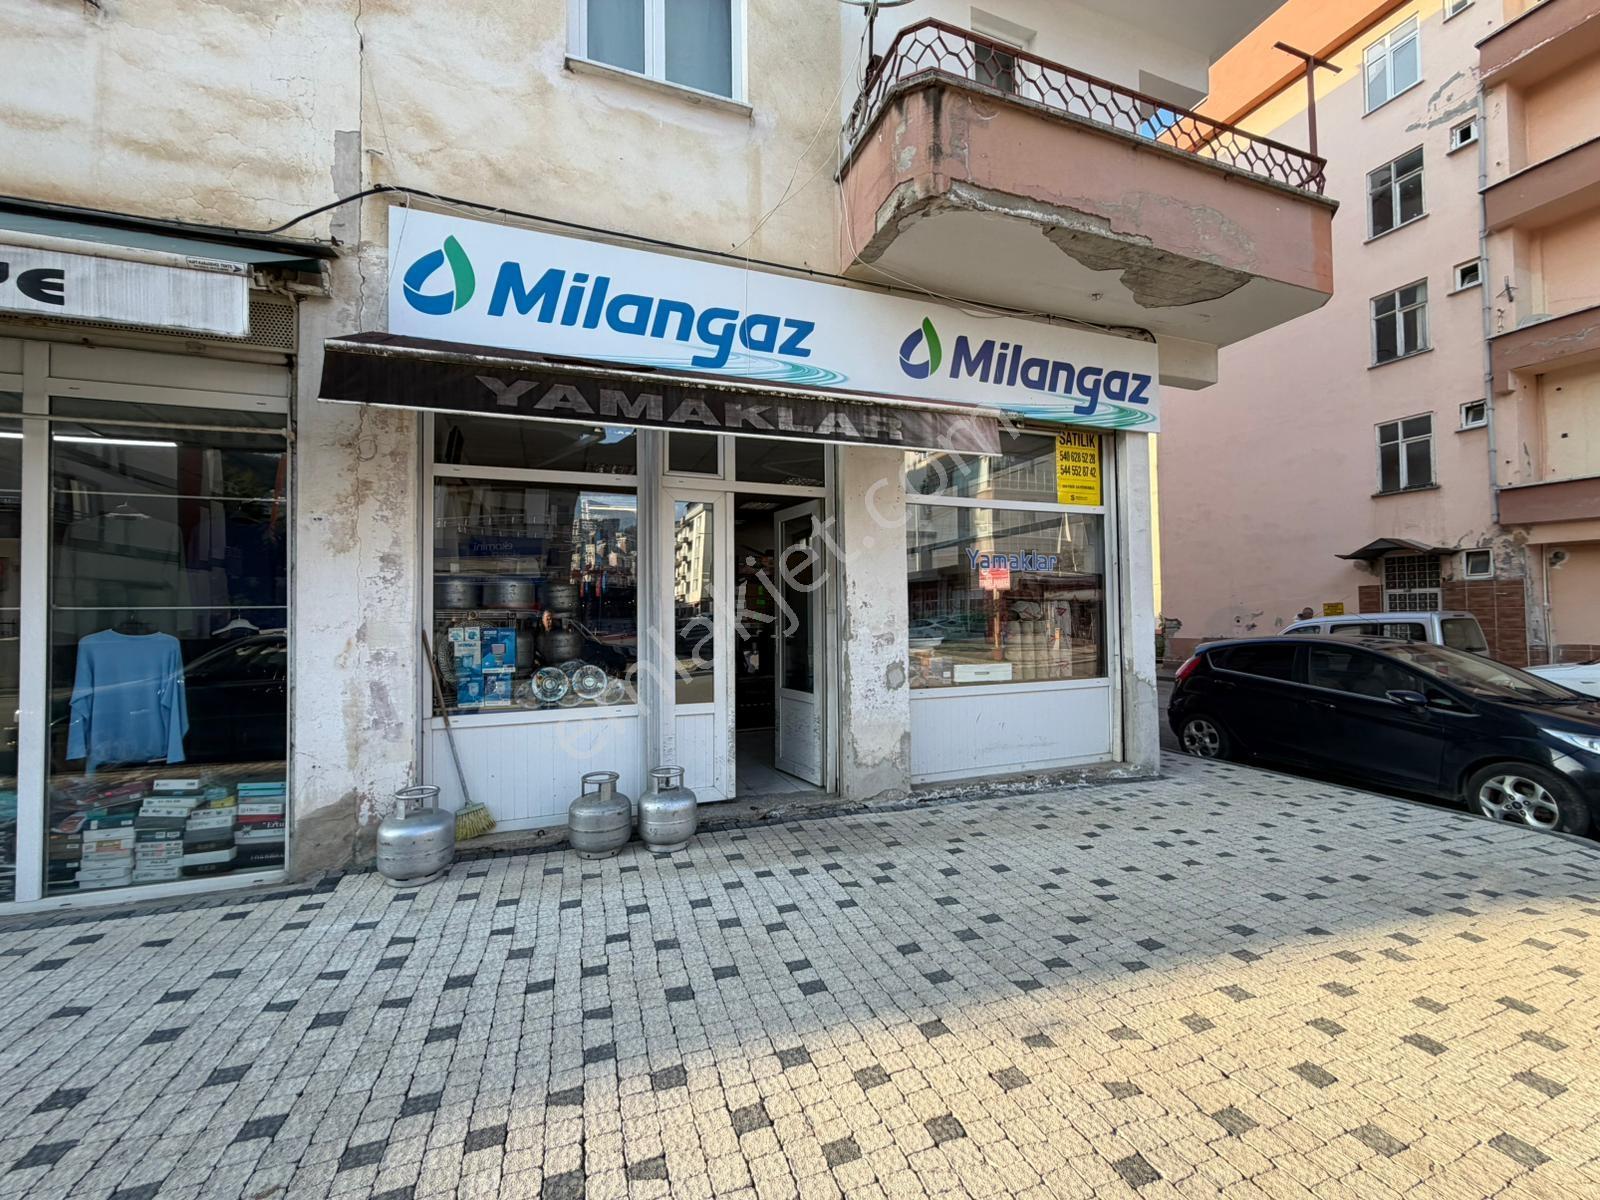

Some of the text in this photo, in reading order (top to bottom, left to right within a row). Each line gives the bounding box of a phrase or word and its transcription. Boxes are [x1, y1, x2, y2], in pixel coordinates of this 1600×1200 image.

[0, 262, 65, 306] E
[487, 261, 815, 369] Milangaz
[949, 335, 1152, 415] Milangaz
[475, 375, 904, 440] YAMAKLAR
[1059, 431, 1096, 448] SATILIK
[965, 547, 1057, 571] Yamaklar
